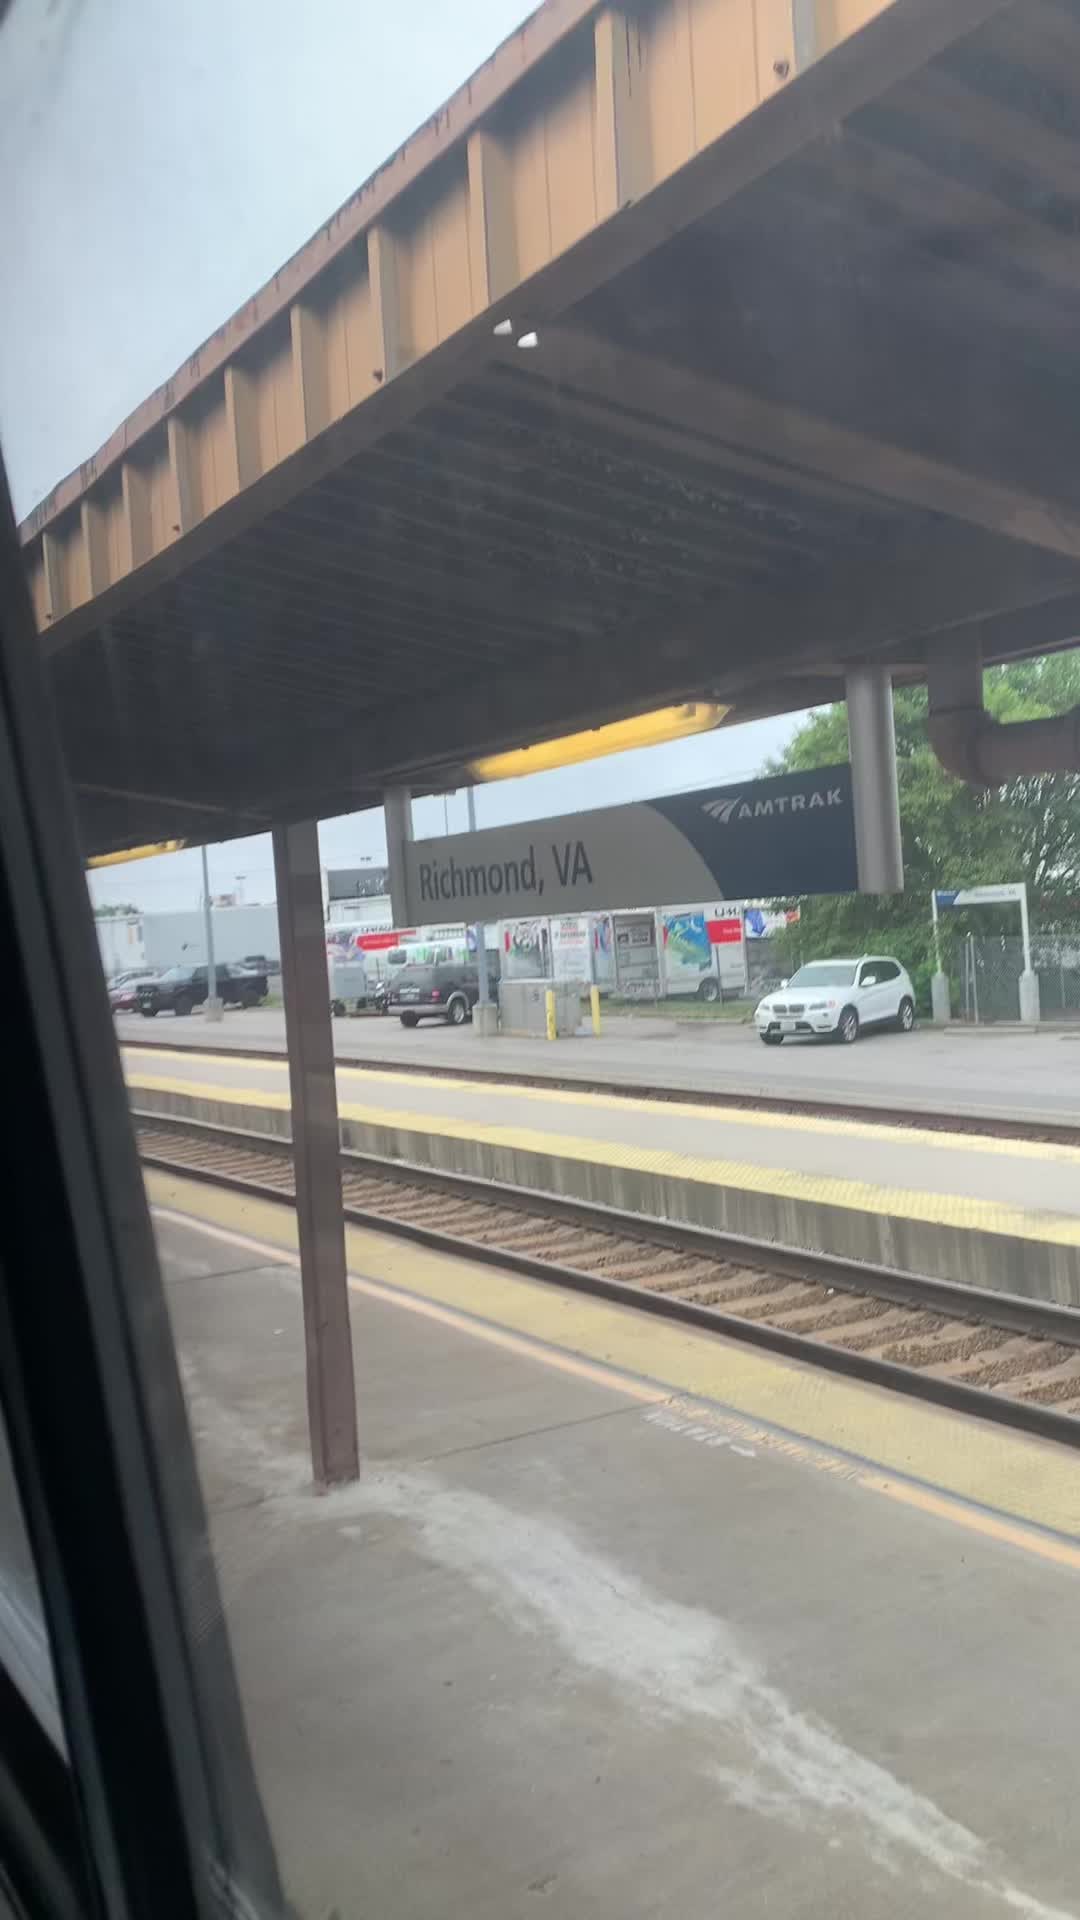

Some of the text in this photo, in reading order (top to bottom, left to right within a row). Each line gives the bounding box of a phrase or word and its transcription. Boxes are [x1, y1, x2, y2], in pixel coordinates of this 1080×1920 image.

[737, 787, 844, 819] AMTRAK
[418, 840, 593, 901] Richmond, VA
